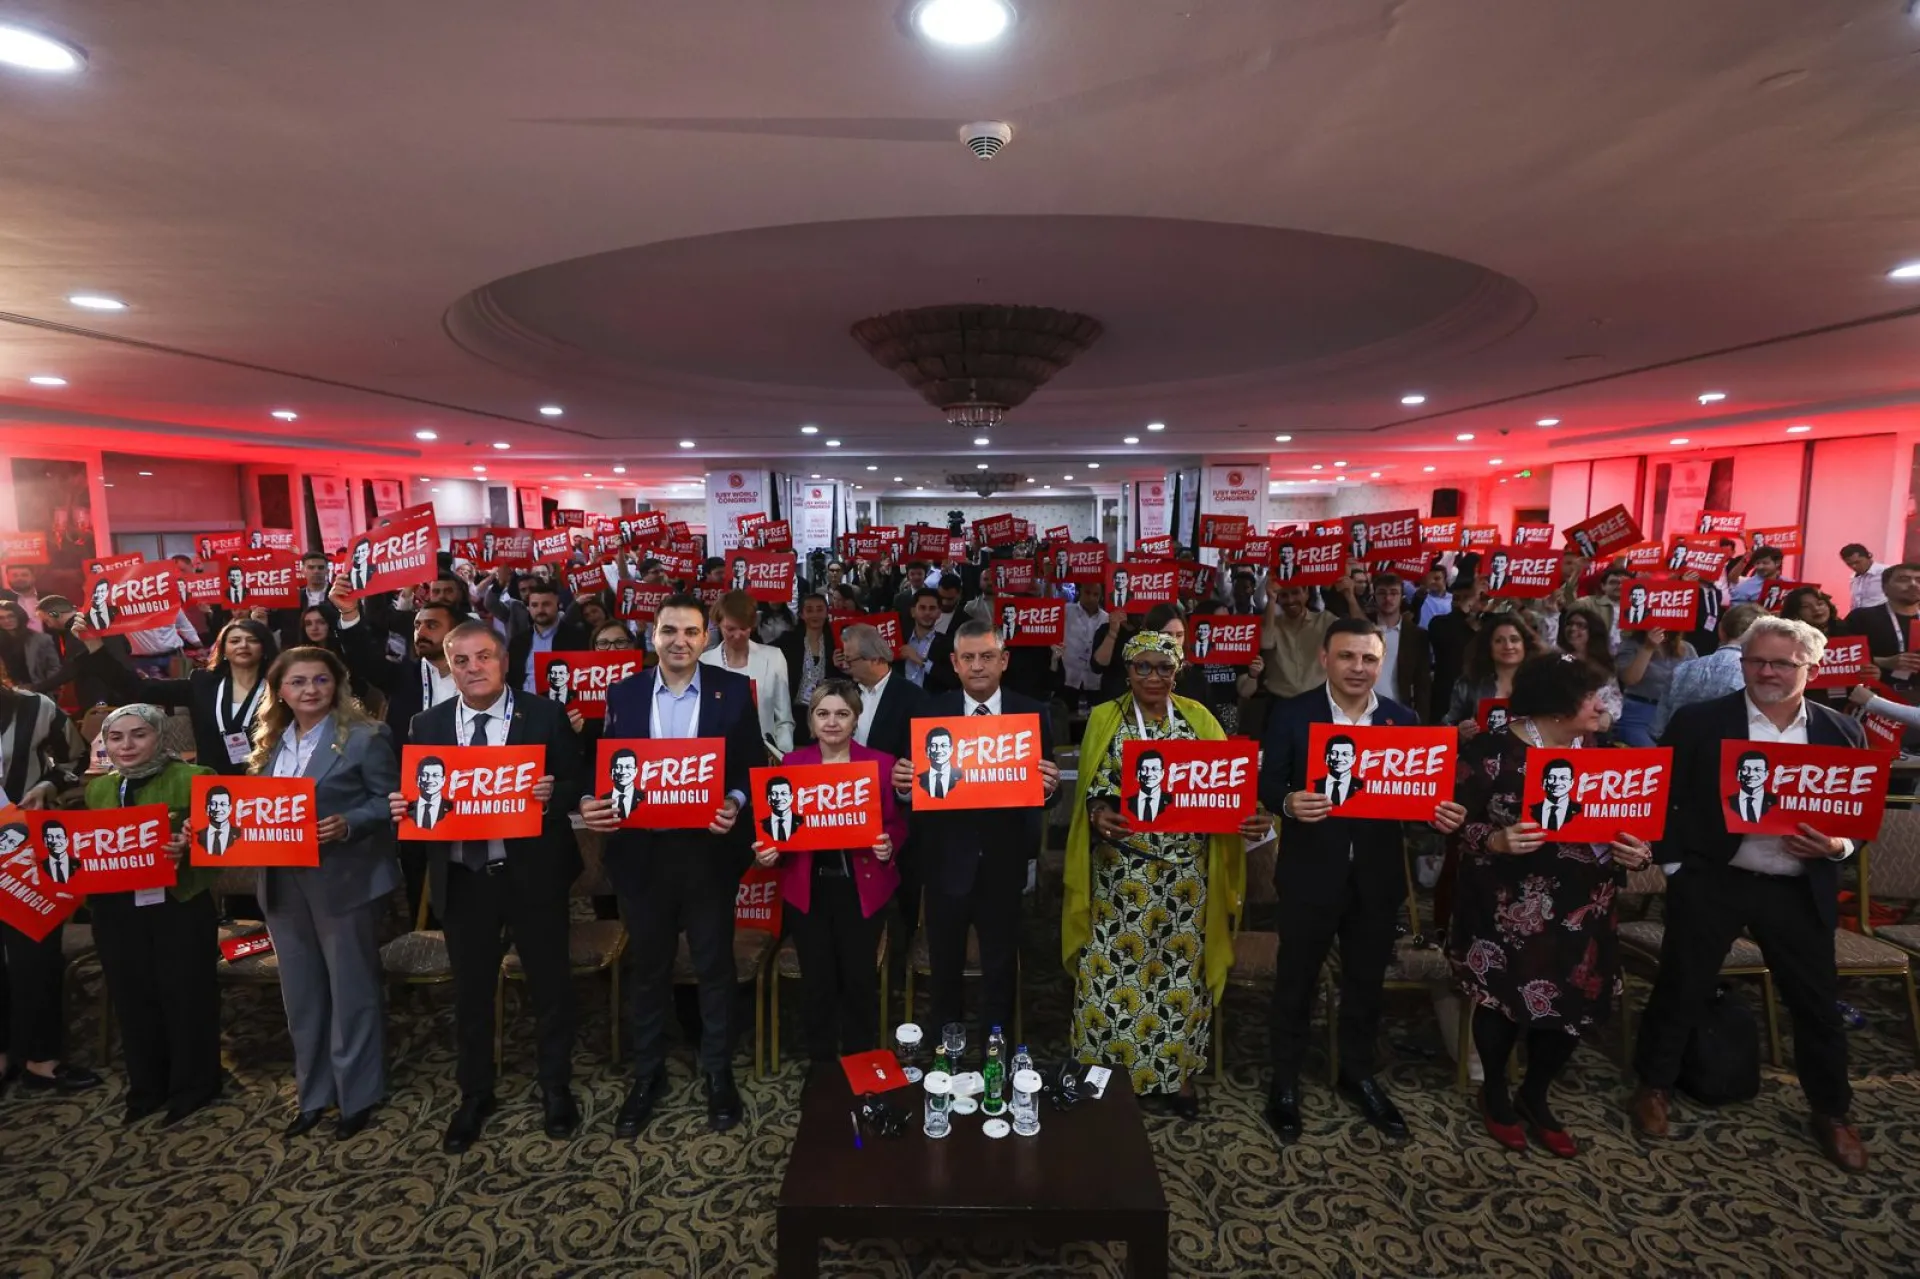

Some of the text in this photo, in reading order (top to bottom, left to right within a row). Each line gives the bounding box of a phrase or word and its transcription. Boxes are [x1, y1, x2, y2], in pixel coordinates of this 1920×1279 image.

[630, 516, 659, 531] FREE
[986, 520, 1010, 533] FREE
[1216, 523, 1245, 534] FREE
[1588, 512, 1627, 541] FREE
[1712, 516, 1742, 526] FREE
[764, 524, 786, 537] FREE
[1369, 518, 1415, 541] FREE
[1424, 523, 1457, 537] FREE
[1525, 528, 1552, 537] FREE
[372, 526, 429, 564] FREE
[496, 536, 531, 550] FREE
[538, 532, 567, 547] FREE
[919, 534, 948, 545] FREE
[950, 543, 964, 551] REE
[1149, 540, 1170, 551] FREE
[1245, 541, 1270, 551] FREE
[1374, 538, 1412, 549] IMAMOGLU
[1069, 551, 1104, 566] FREE
[1296, 542, 1342, 565] FREE
[1629, 547, 1660, 560] FREE
[1686, 551, 1724, 564] FREE
[378, 554, 426, 575] IMAMOGLU
[748, 562, 790, 579] FREE
[1006, 565, 1032, 578] FREE
[1302, 564, 1338, 573] IMAMOGLU
[1509, 558, 1557, 576] FREE
[245, 568, 292, 588] FREE
[576, 566, 601, 583] FREE
[1130, 572, 1174, 590] FREE
[1512, 576, 1550, 586] IMAMOGLU
[111, 572, 169, 606] FREE
[187, 577, 220, 592] FREE
[250, 588, 288, 596] IMAMOGLU
[751, 581, 786, 589] IMAMOGLU
[1134, 592, 1169, 600] IMAMOGLU
[1648, 589, 1694, 608] FREE
[120, 600, 169, 616] IMAMOGLU
[1018, 606, 1061, 624] FREE
[1652, 608, 1689, 618] IMAMOGLU
[877, 620, 895, 637] EE
[1022, 625, 1056, 634] IMAMOGLU
[1212, 624, 1256, 642] FREE
[1216, 643, 1251, 652] IMAMOGLU
[1823, 644, 1862, 665] REE
[572, 662, 636, 690] FREE
[957, 730, 1032, 768] FREE
[1358, 745, 1447, 778] FREE
[640, 752, 717, 790] FREE
[964, 767, 1027, 783] IMAMOGLU
[1168, 757, 1249, 793] FREE
[1772, 764, 1878, 794] FREE
[449, 762, 536, 799] FREE
[1366, 780, 1436, 797] IMAMOGLU
[1576, 765, 1663, 802] FREE
[647, 789, 709, 805] IMAMOGLU
[797, 777, 872, 814] FREE
[1175, 792, 1240, 808] IMAMOGLU
[235, 794, 307, 826] FREE
[456, 798, 526, 815] IMAMOGLU
[1584, 802, 1651, 818] IMAMOGLU
[1780, 798, 1863, 817] IMAMOGLU
[806, 812, 866, 828] IMAMOGLU
[73, 820, 159, 858] FREE
[244, 828, 303, 842] IMAMOGLU
[84, 853, 155, 872] IMAMOGLU
[736, 881, 777, 906] REE
[736, 908, 771, 920] AMOGLU
